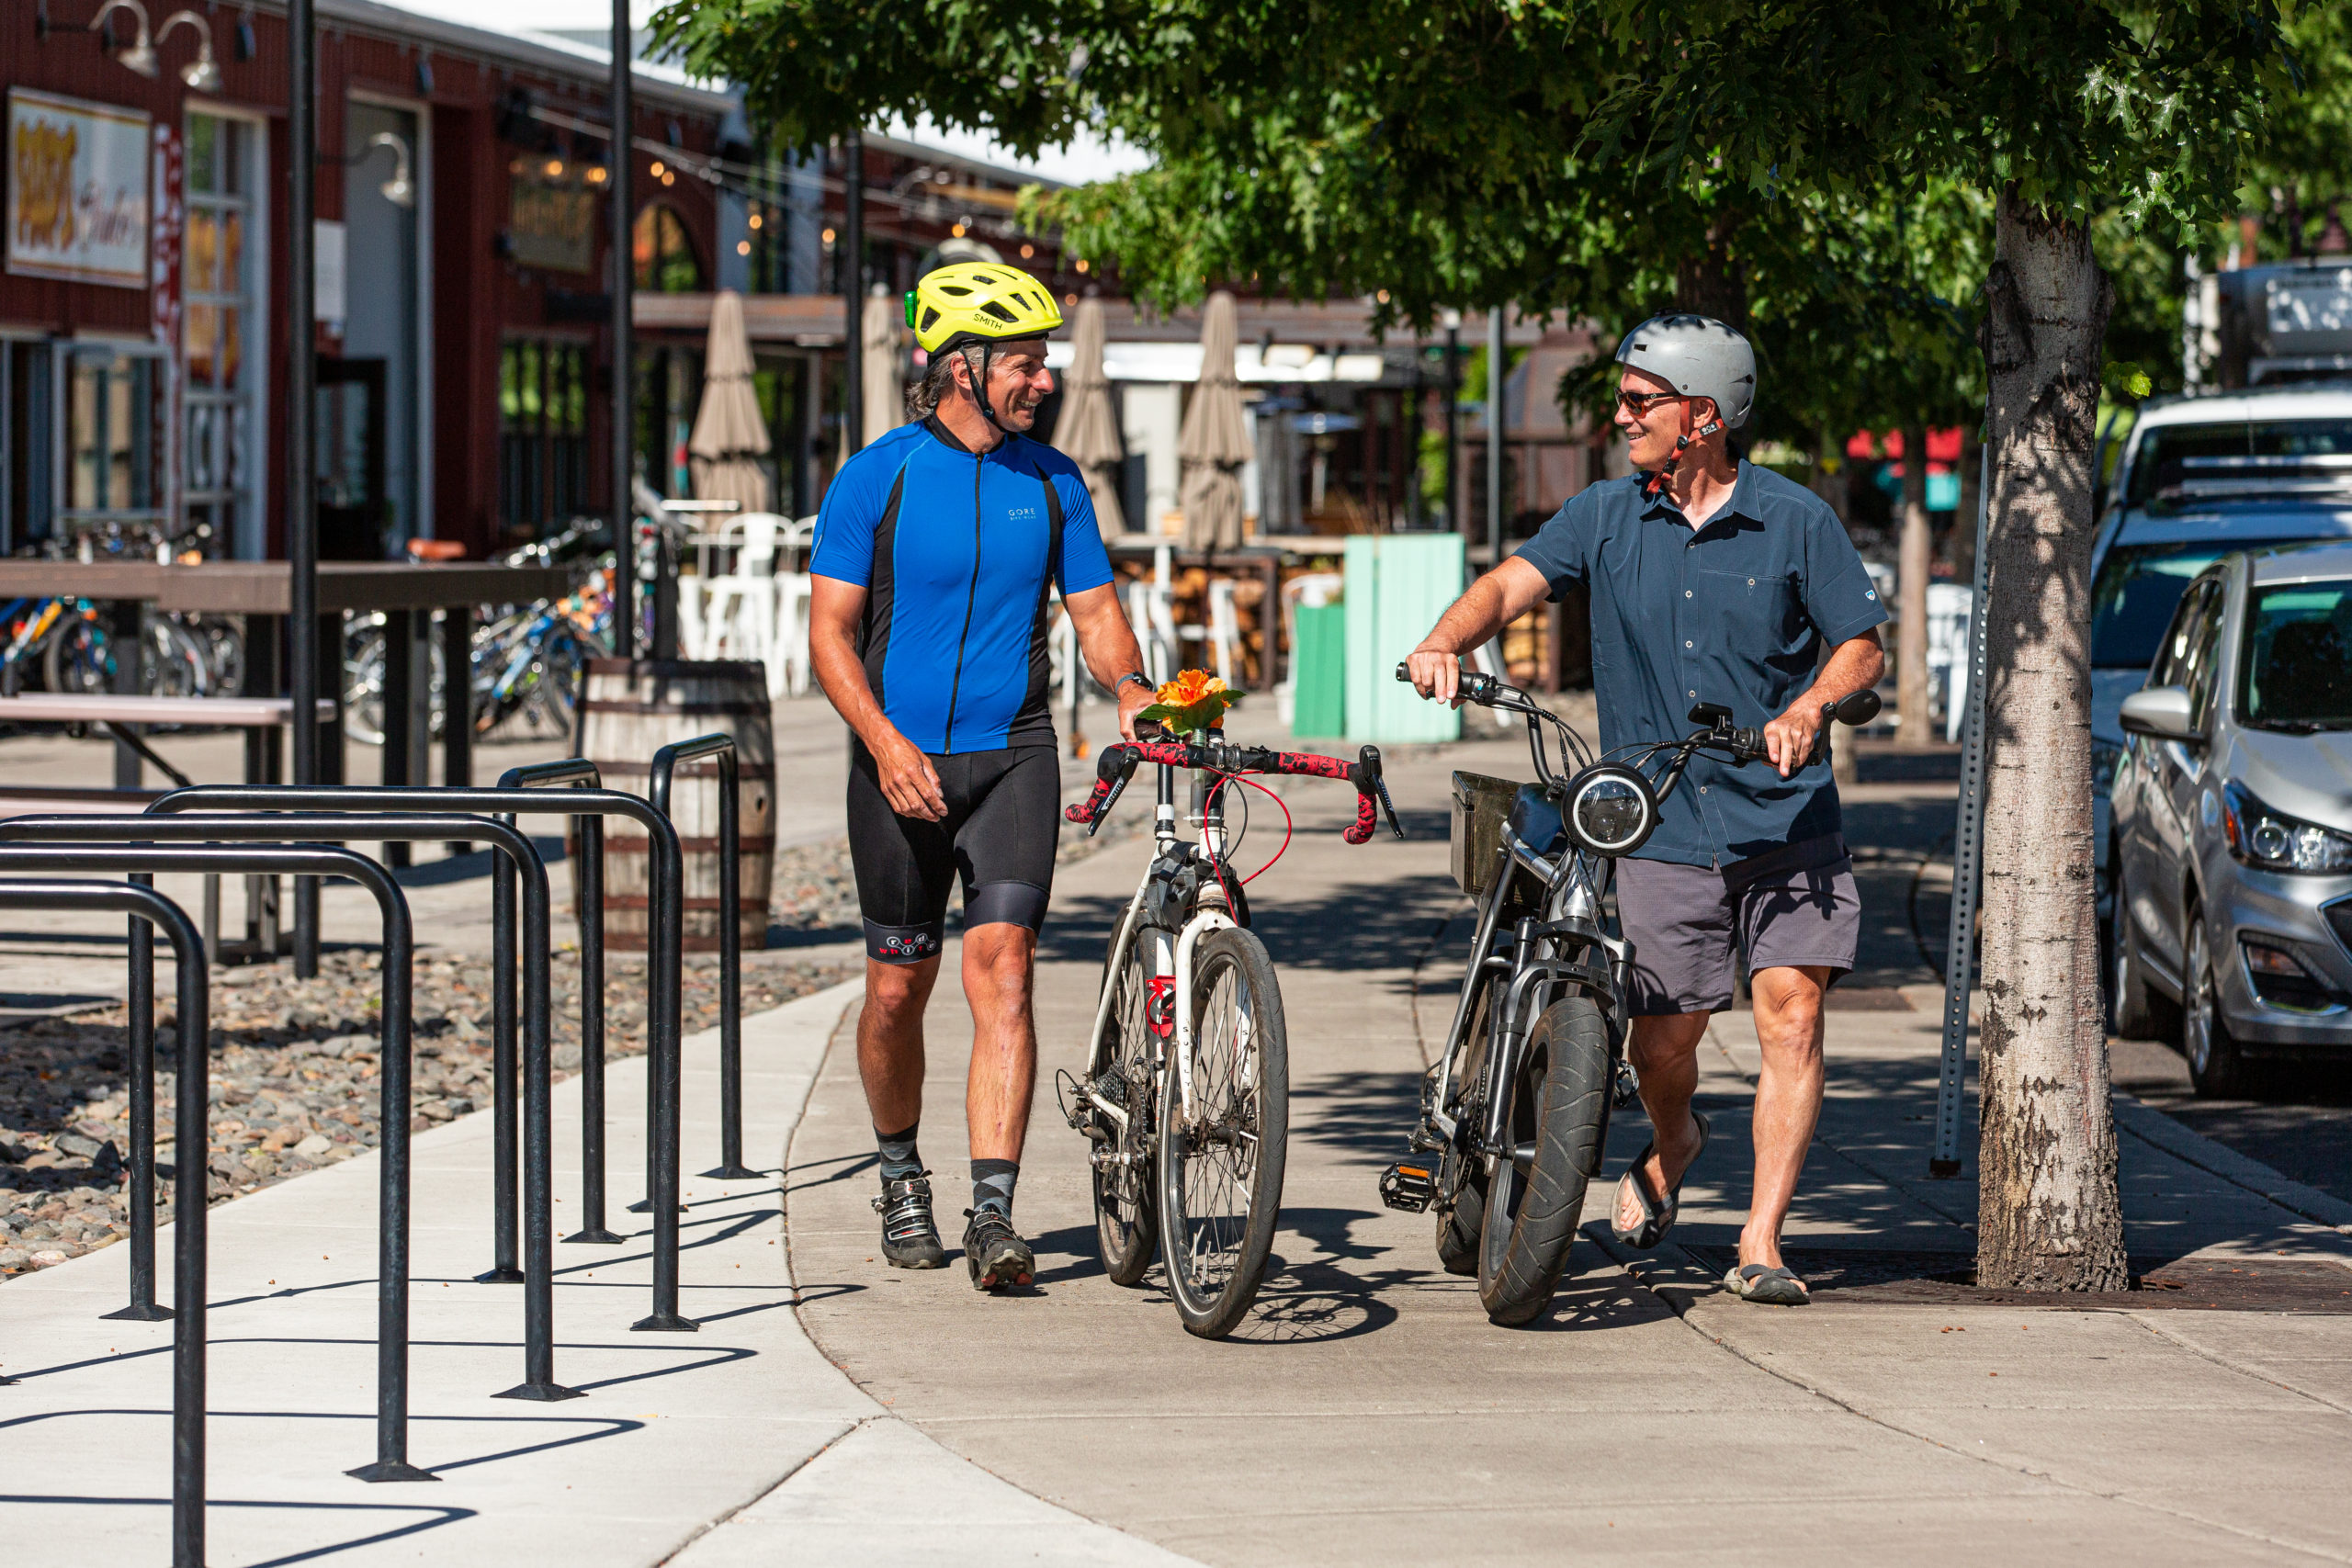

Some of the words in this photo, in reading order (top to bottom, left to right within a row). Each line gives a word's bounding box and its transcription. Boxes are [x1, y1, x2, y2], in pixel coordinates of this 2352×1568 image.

[974, 313, 1002, 330] SMITH
[1008, 507, 1035, 516] GORE
[1182, 1026, 1192, 1087] SURLY
